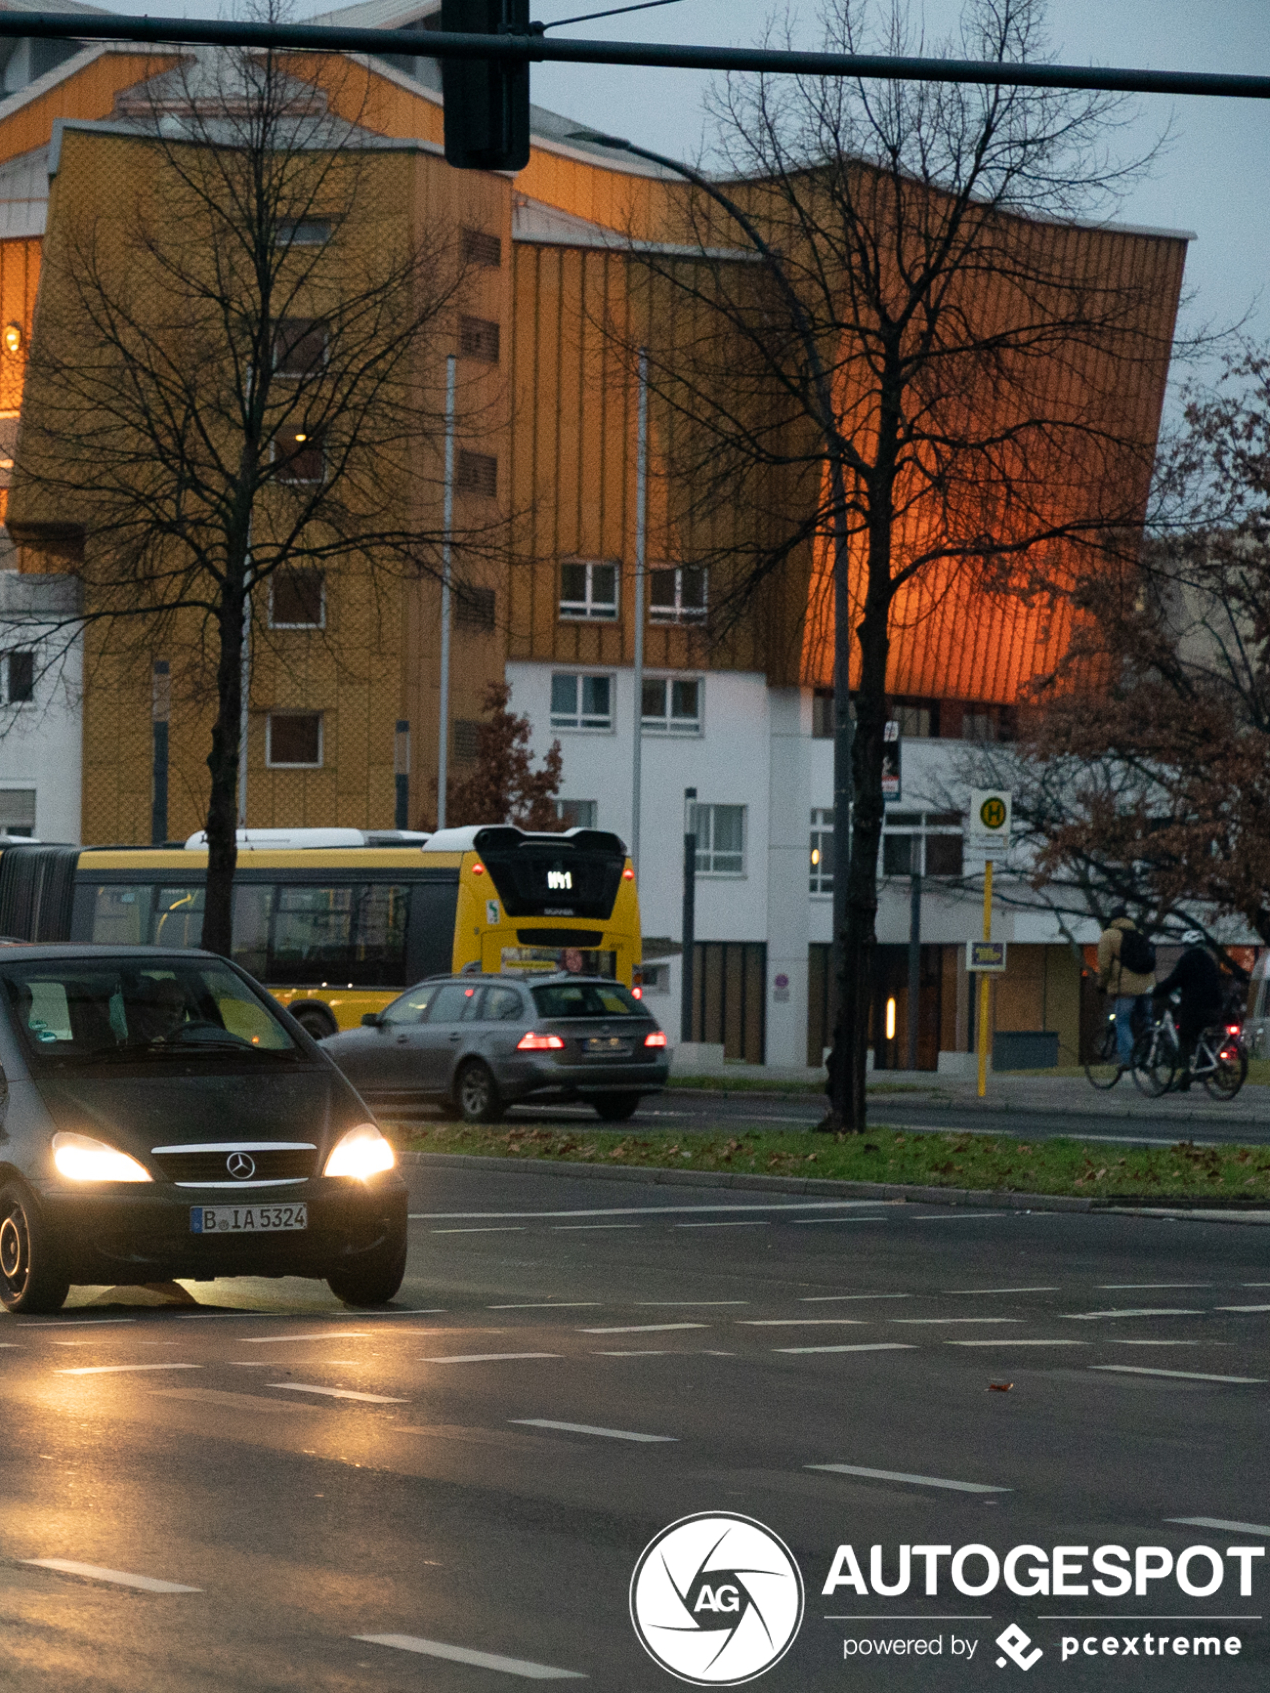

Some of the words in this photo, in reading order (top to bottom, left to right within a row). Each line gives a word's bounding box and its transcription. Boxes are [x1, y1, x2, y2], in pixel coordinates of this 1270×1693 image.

[988, 804, 1001, 821] H
[204, 1210, 216, 1230] B
[232, 1209, 255, 1229] IA
[260, 1207, 305, 1228] 5324
